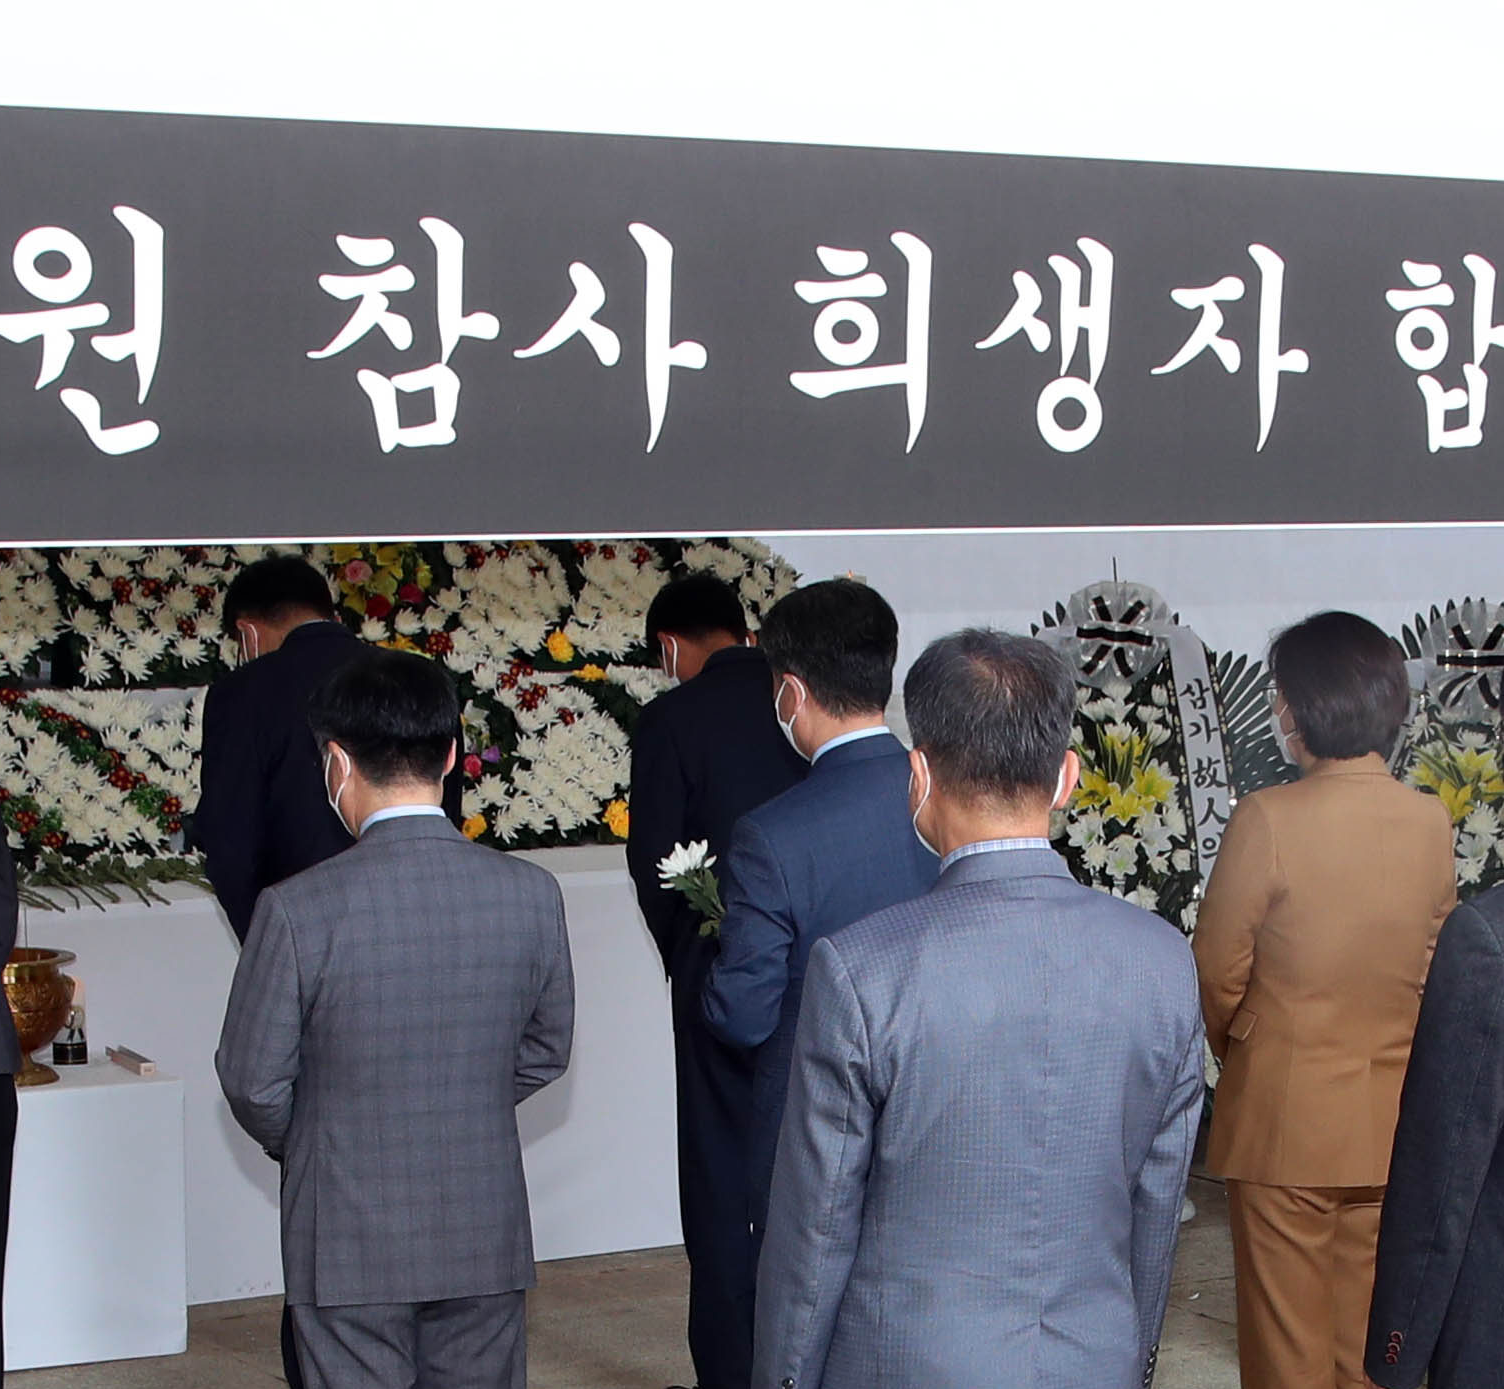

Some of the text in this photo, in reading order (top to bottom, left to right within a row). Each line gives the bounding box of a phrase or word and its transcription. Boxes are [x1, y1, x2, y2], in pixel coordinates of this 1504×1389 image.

[306, 217, 708, 454] 참사
[789, 231, 1309, 454] 희생자
[1179, 678, 1218, 744] 삼가
